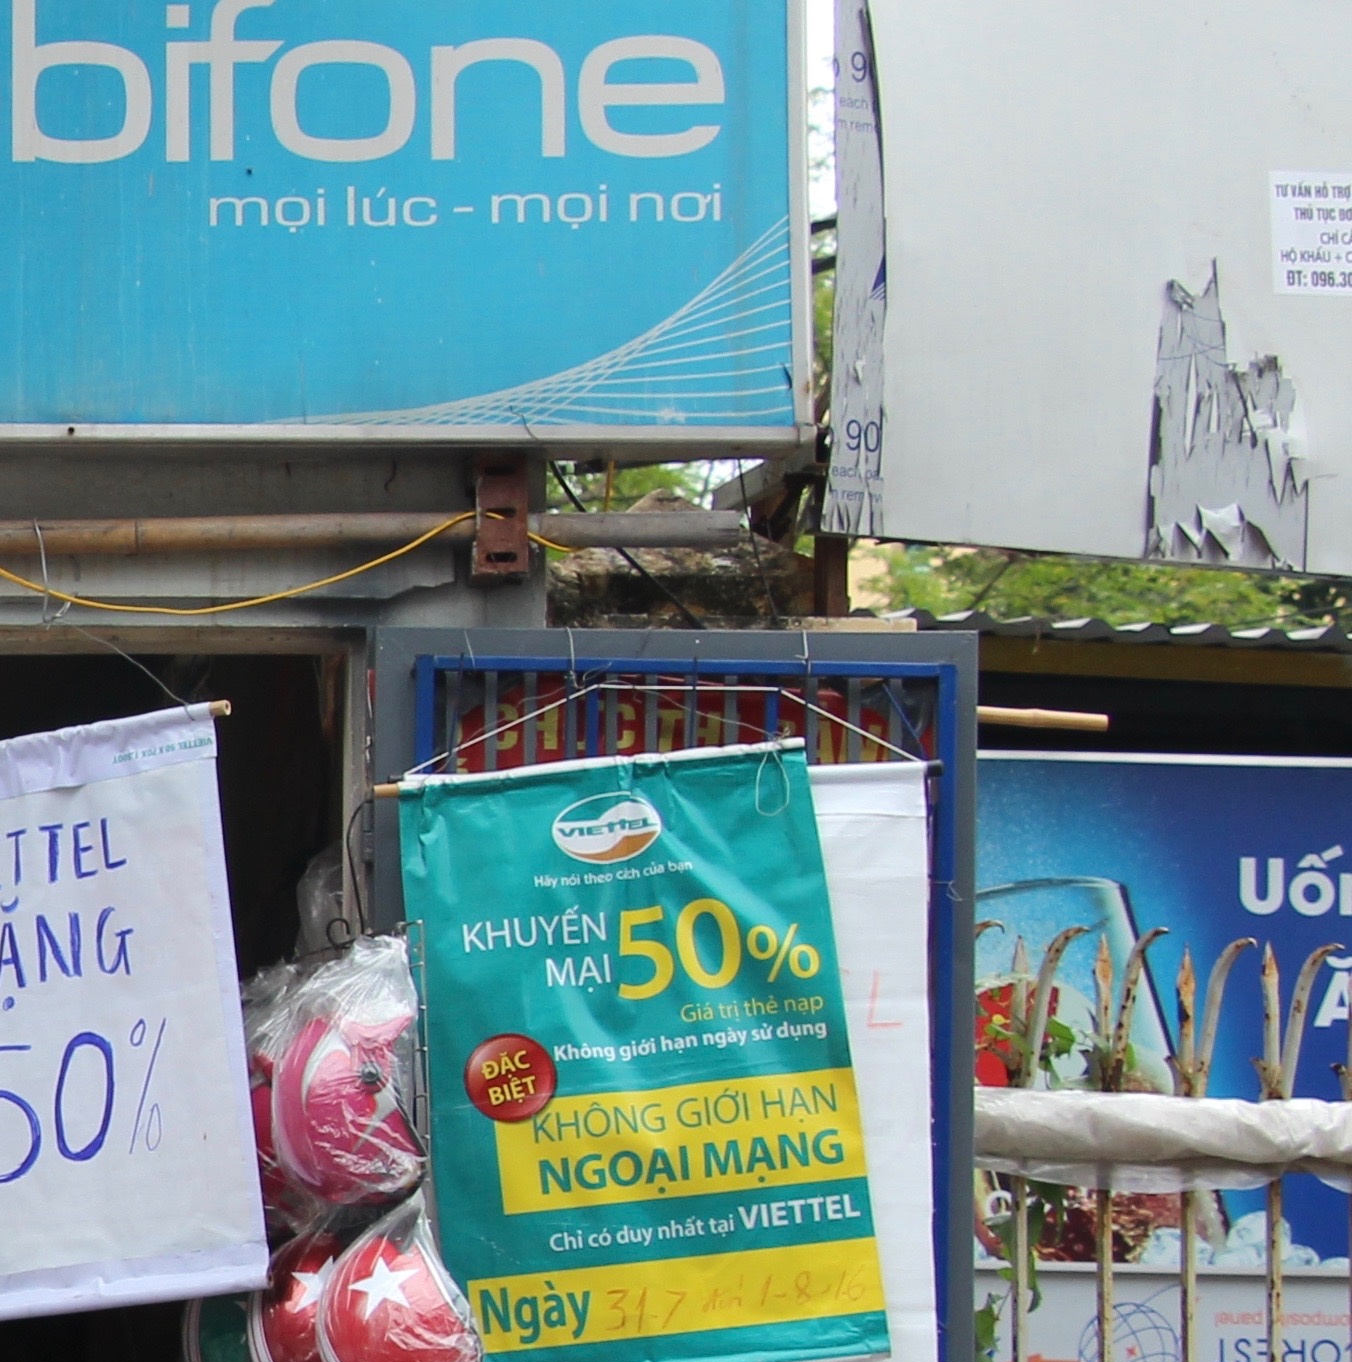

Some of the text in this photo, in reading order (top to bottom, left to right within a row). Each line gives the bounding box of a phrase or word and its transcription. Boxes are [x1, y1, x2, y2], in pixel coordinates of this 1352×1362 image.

[207, 183, 724, 231] mọi lúc mọi nơi
[556, 816, 654, 838] VIETTEL
[462, 897, 821, 1000] KHUYẾN 50%
[545, 954, 612, 993] MẠI
[680, 994, 825, 1023] Giá trị thẻ nạp
[554, 1020, 828, 1062] Không giới hạn ngày sử dụng
[481, 1049, 531, 1083] ĐẶC
[487, 1074, 538, 1107] BIỆT
[532, 1082, 839, 1145] KHÔNG GIỚI HẠN
[539, 1128, 845, 1195] NGOẠI MẠNG
[549, 1193, 861, 1253] Chỉ có duy nhất tại VIETTEL
[480, 1281, 592, 1345] Ngày
